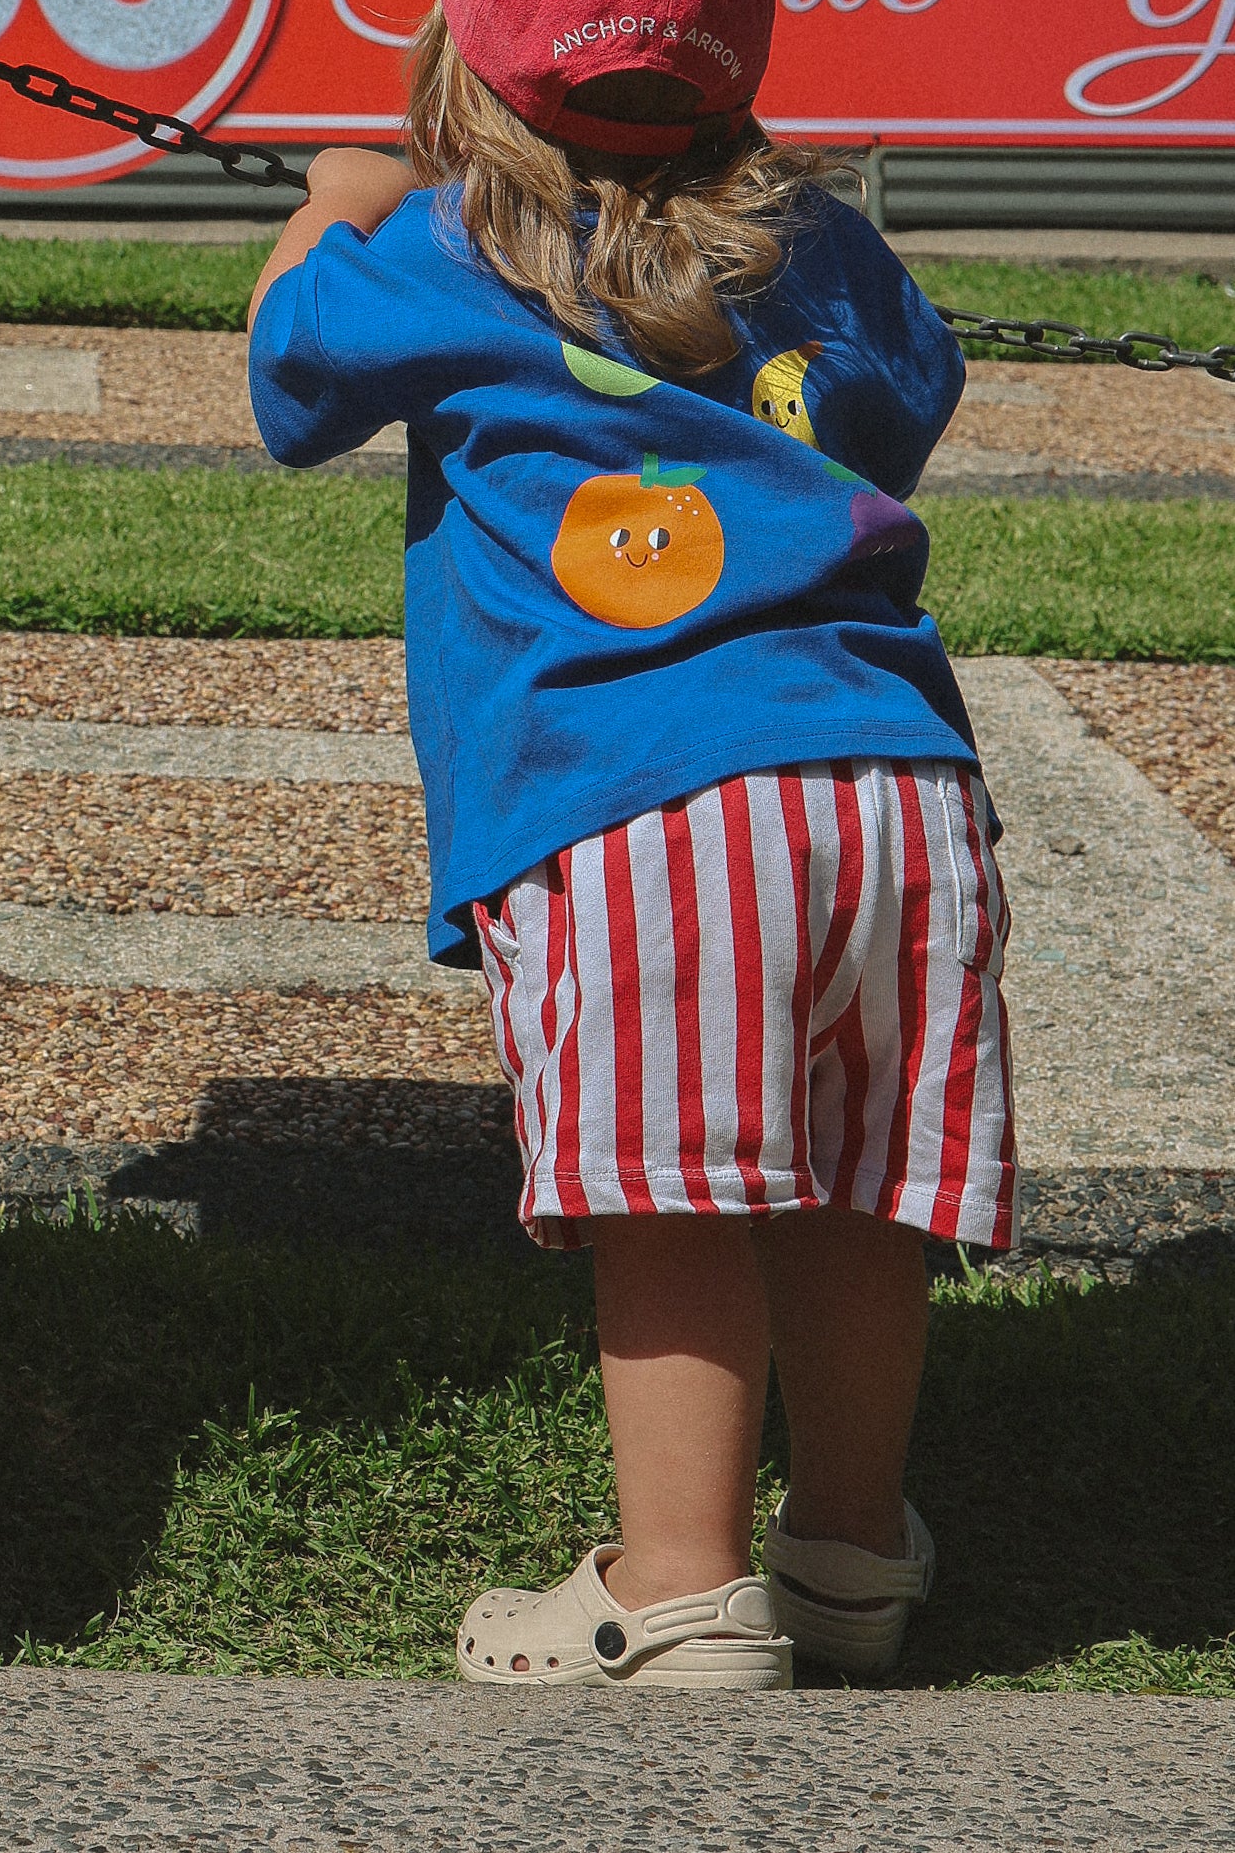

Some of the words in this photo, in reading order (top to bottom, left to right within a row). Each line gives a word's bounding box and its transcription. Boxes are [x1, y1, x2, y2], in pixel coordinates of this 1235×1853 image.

[551, 15, 656, 61] ANCHOR
[662, 20, 680, 41] &
[682, 27, 743, 80] ARROW
